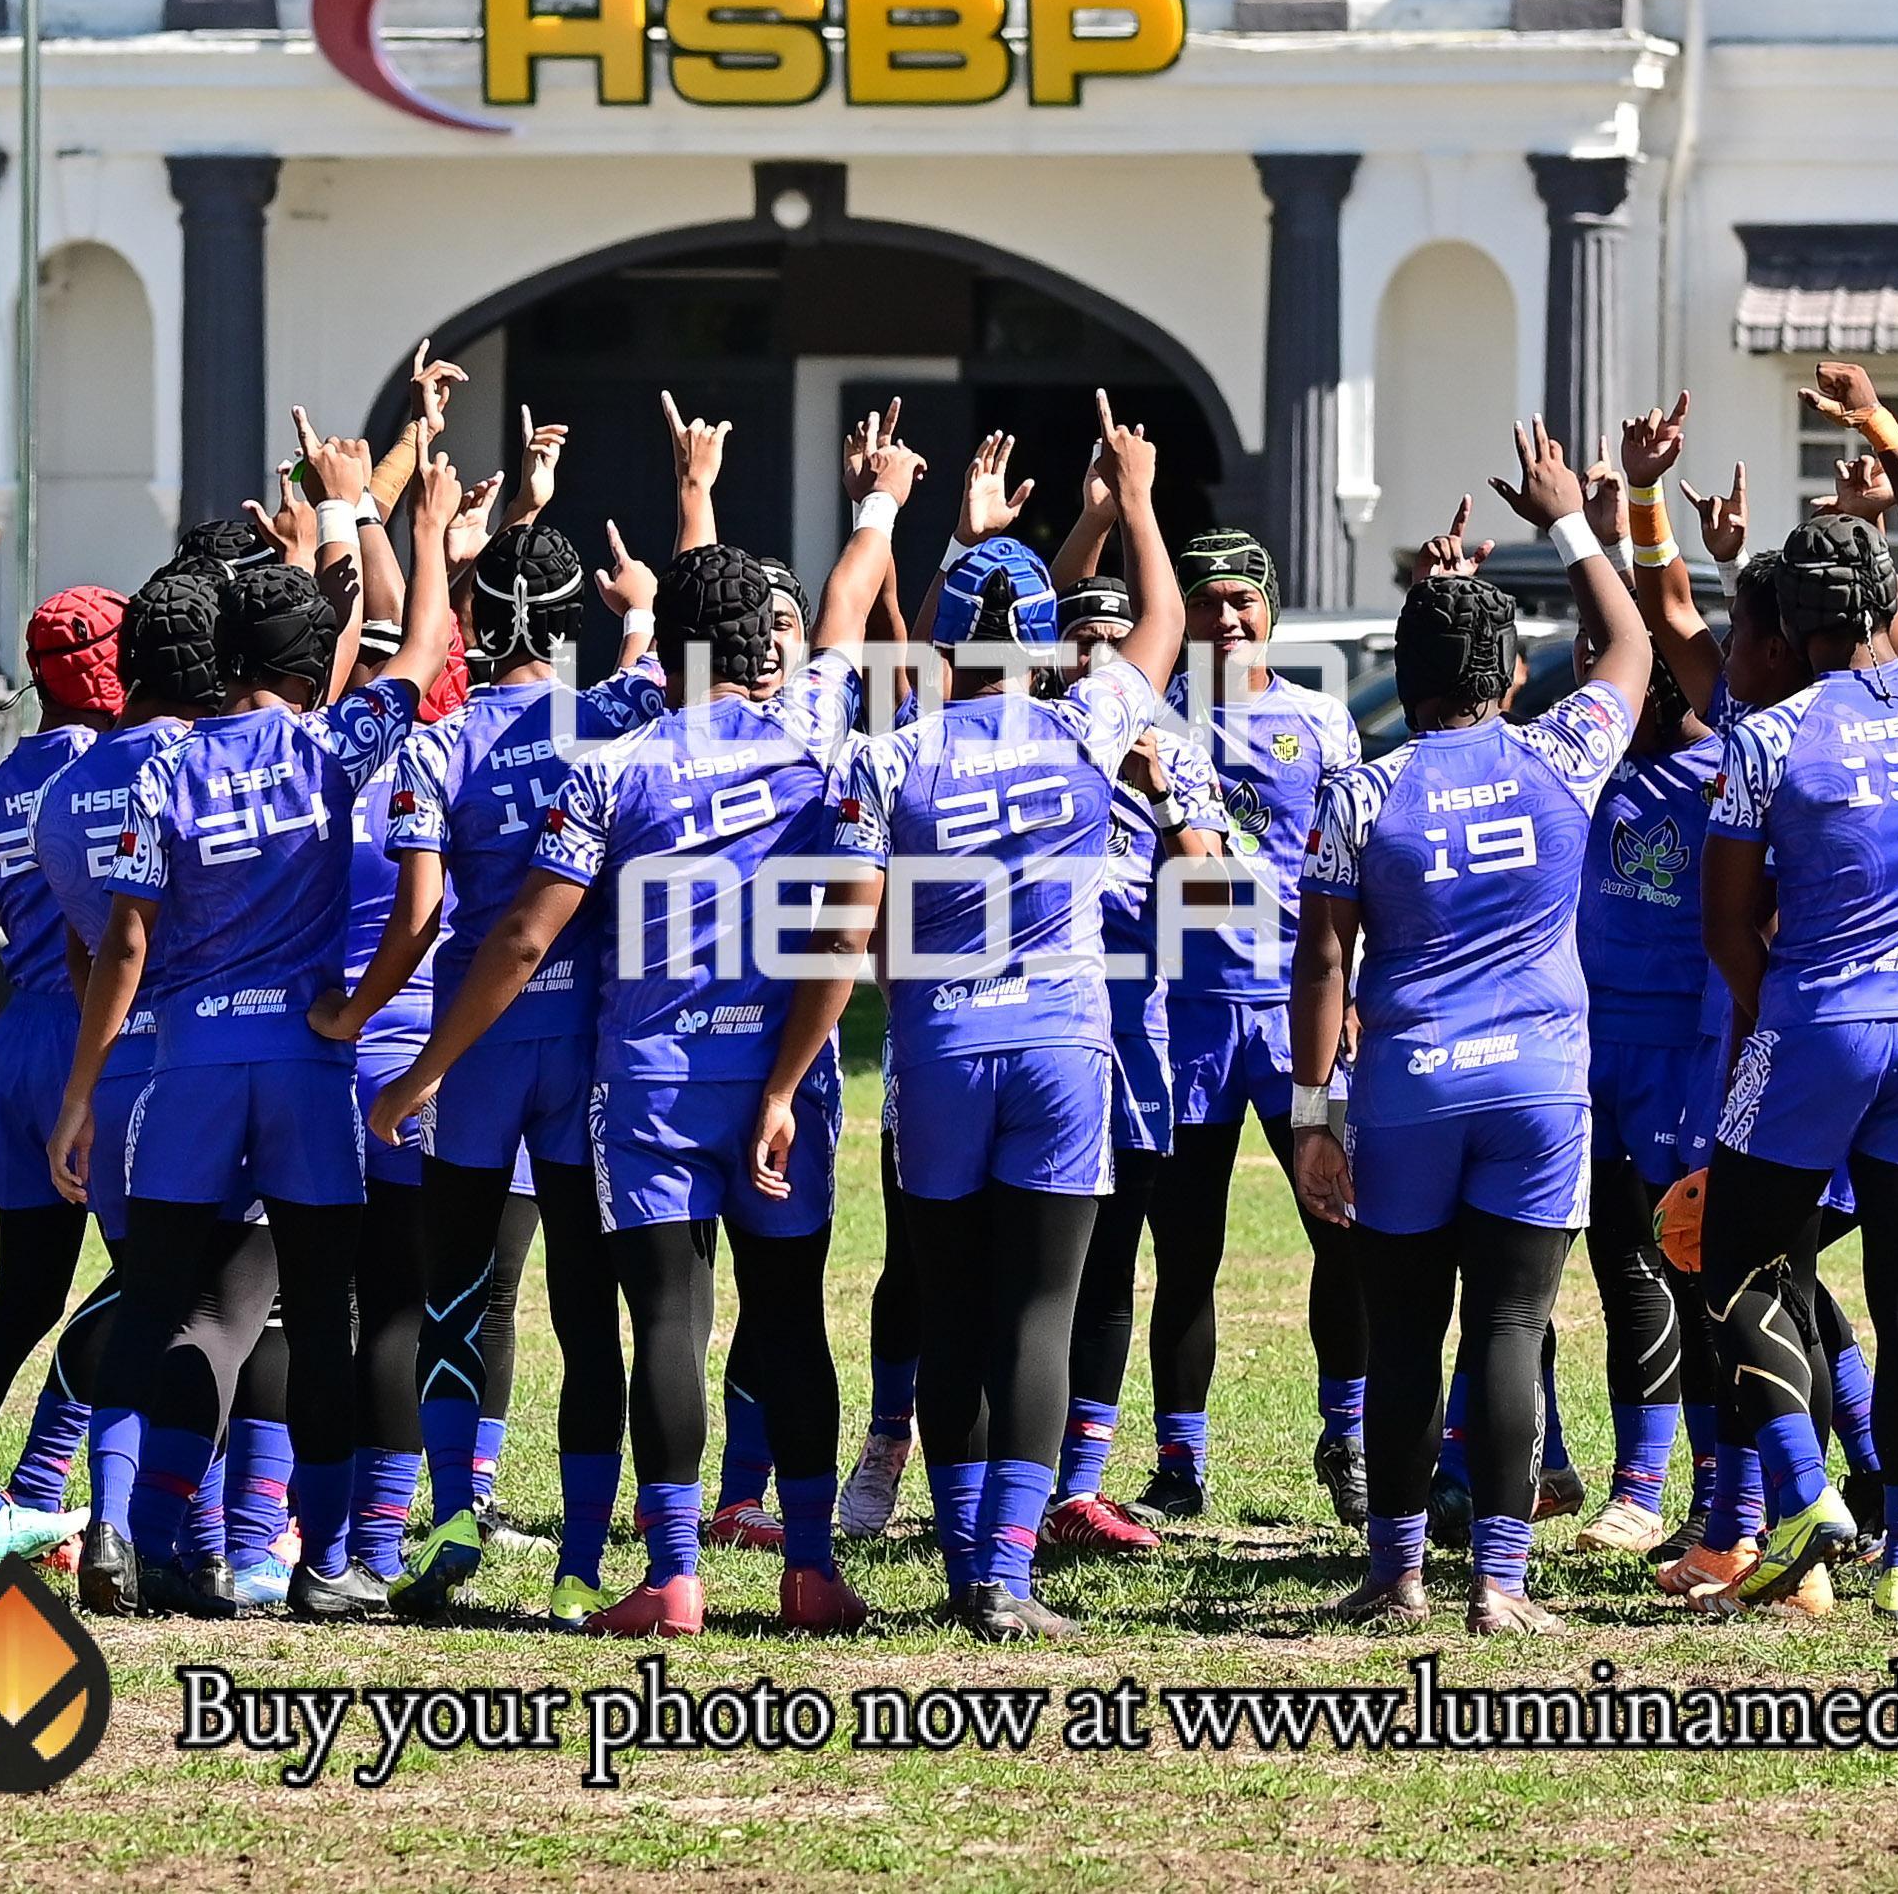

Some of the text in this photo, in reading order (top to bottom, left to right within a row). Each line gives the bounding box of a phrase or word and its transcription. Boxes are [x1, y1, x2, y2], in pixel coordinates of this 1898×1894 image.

[490, 732, 576, 771] HSBP
[669, 746, 760, 784] HSBP
[949, 742, 1040, 780] HSBP
[206, 760, 295, 799] HSBP
[1426, 778, 1521, 814] HSBP
[70, 787, 130, 815] HSB
[669, 778, 777, 848] 18
[933, 774, 1077, 852] 20
[194, 791, 331, 867] 24
[1422, 814, 1539, 884] 19
[1600, 877, 1682, 907] Aura Flow
